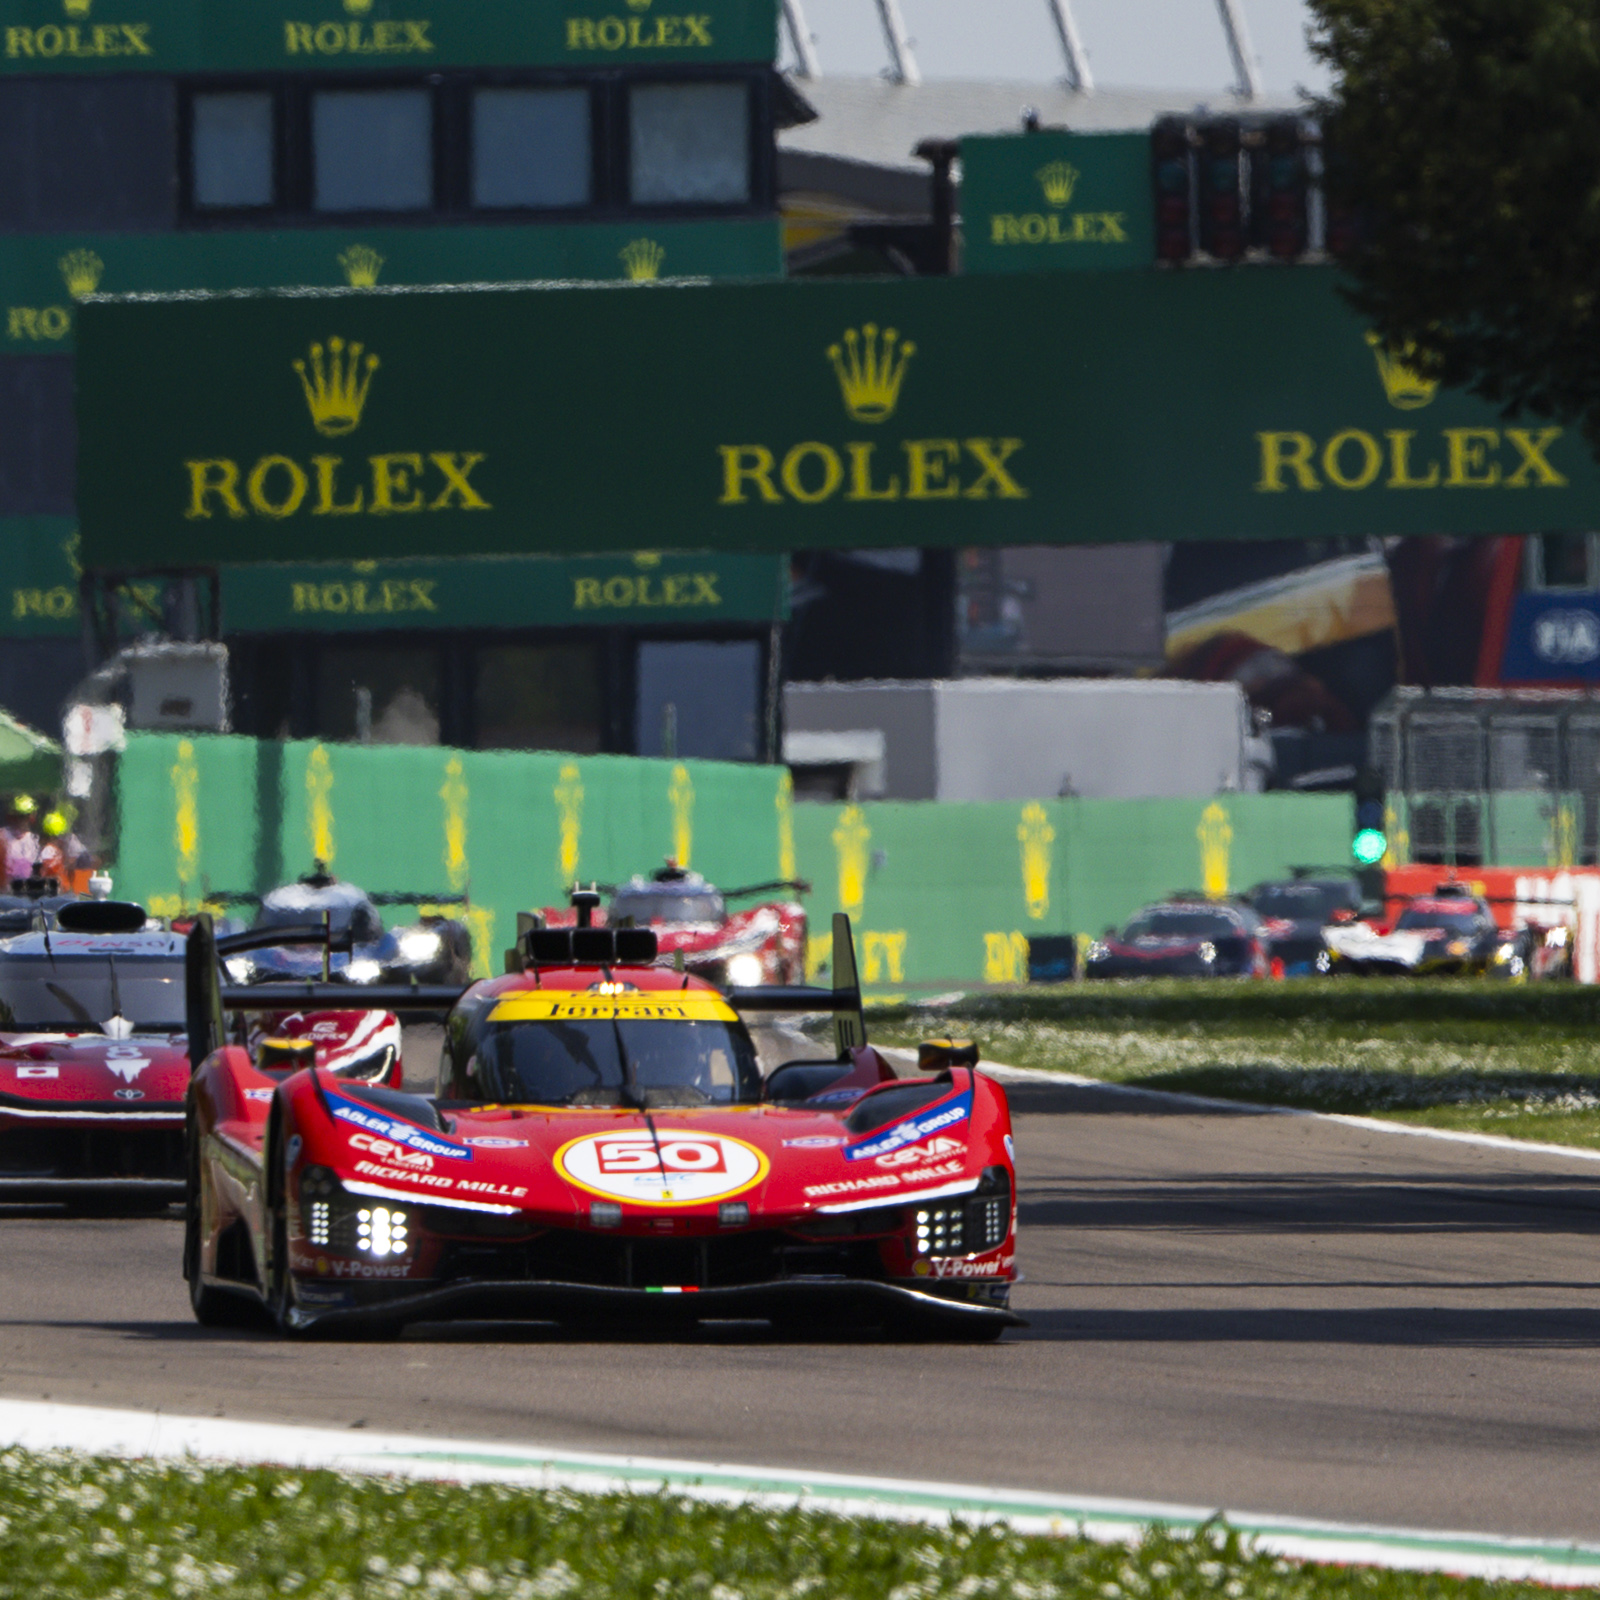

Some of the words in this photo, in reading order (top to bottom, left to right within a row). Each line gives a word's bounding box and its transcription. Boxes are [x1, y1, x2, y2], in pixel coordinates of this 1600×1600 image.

[4, 23, 153, 59] ROLEX
[284, 19, 435, 55] ROLEX
[565, 15, 714, 51] ROLEX
[990, 211, 1128, 245] ROLEX
[719, 438, 1026, 504] ROLEX
[1258, 425, 1568, 492] ROLEX
[185, 451, 492, 519] ROLEX
[291, 581, 437, 614] ROLEX
[572, 574, 721, 610] ROLEX
[333, 1106, 389, 1134] ADLER
[408, 1135, 468, 1159] GROUP
[852, 1135, 901, 1160] ADLER
[917, 1106, 966, 1135] GROUP
[600, 1142, 720, 1171] 50
[353, 1159, 453, 1189] RICHARD
[456, 1179, 529, 1198] MILLE
[803, 1174, 901, 1197] RICHARD
[901, 1159, 965, 1183] MILLE
[332, 1259, 412, 1277] V-Power
[934, 1260, 999, 1278] V-Power
